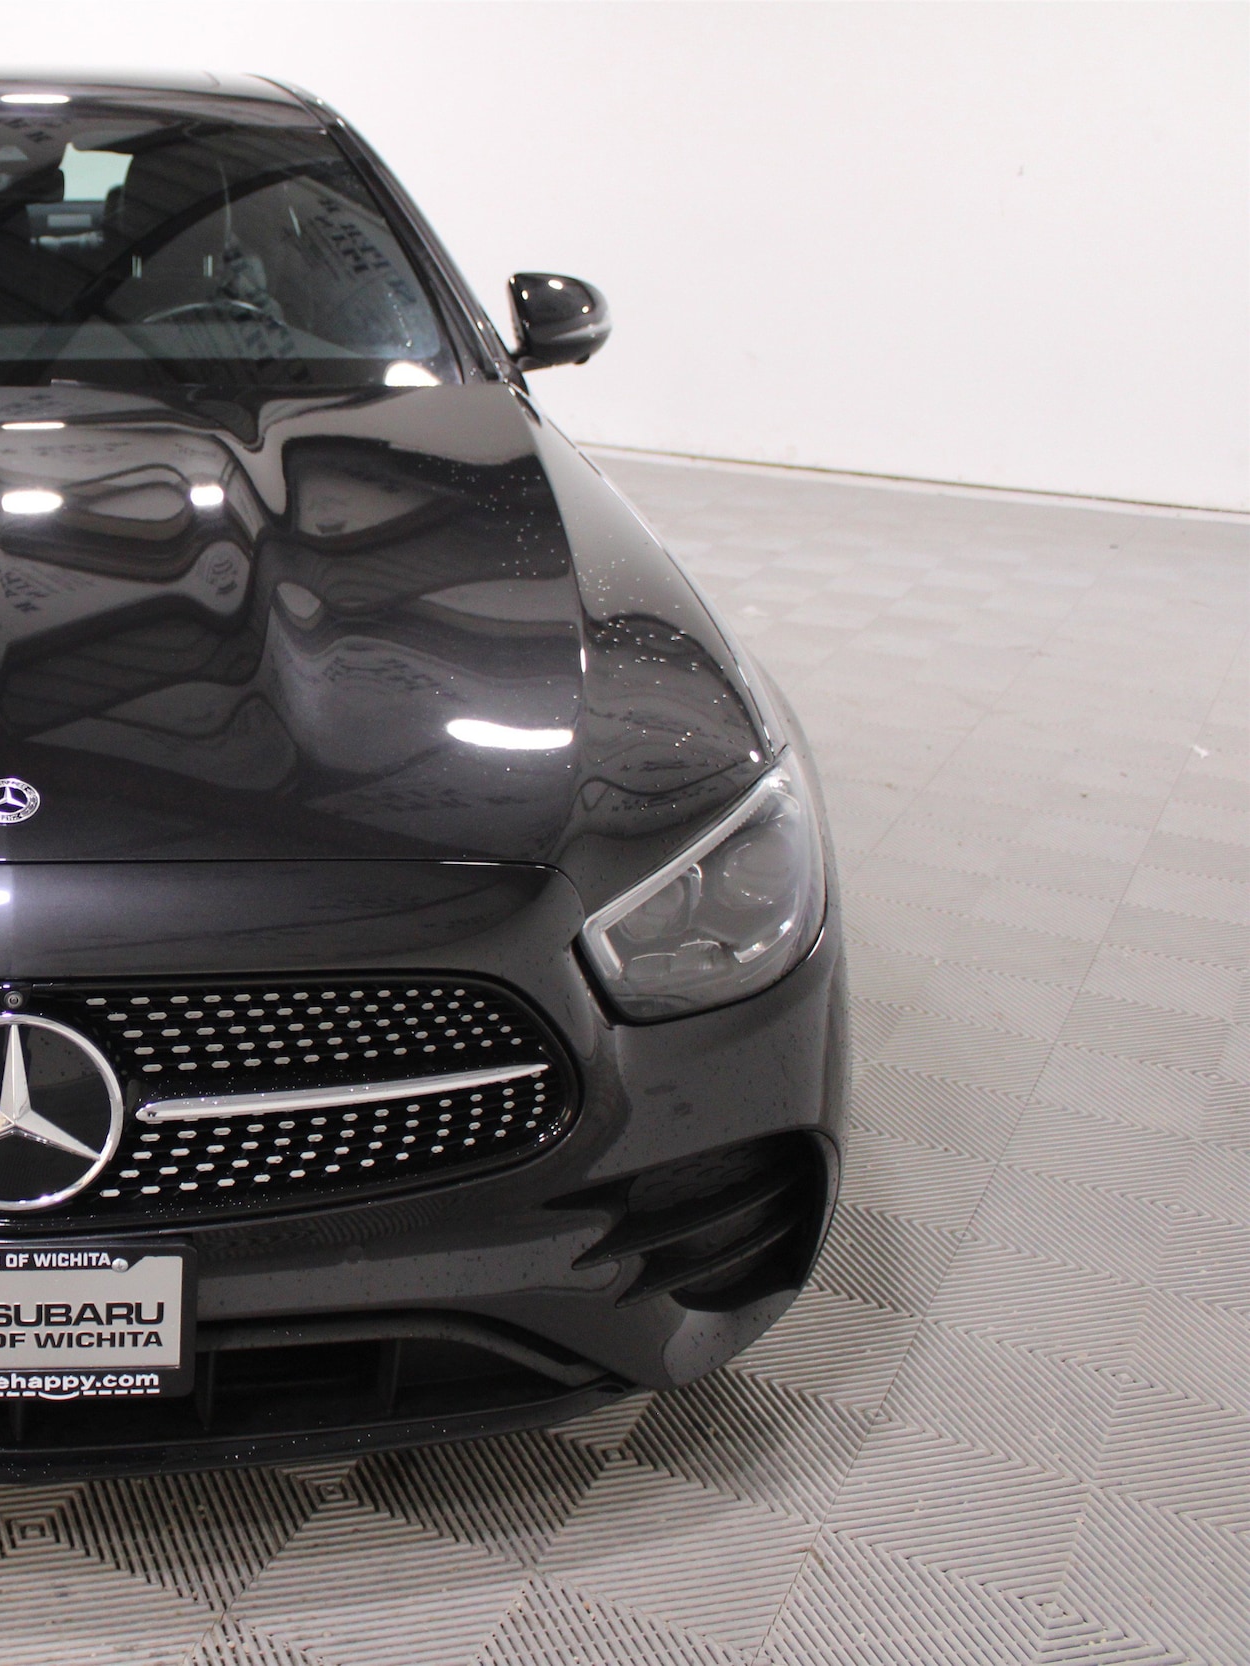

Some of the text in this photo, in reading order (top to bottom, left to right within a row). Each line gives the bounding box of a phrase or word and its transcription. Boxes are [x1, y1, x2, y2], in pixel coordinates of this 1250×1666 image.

[6, 1254, 29, 1268] OF
[34, 1252, 112, 1268] WICHITA
[34, 1330, 164, 1349] WICHITA
